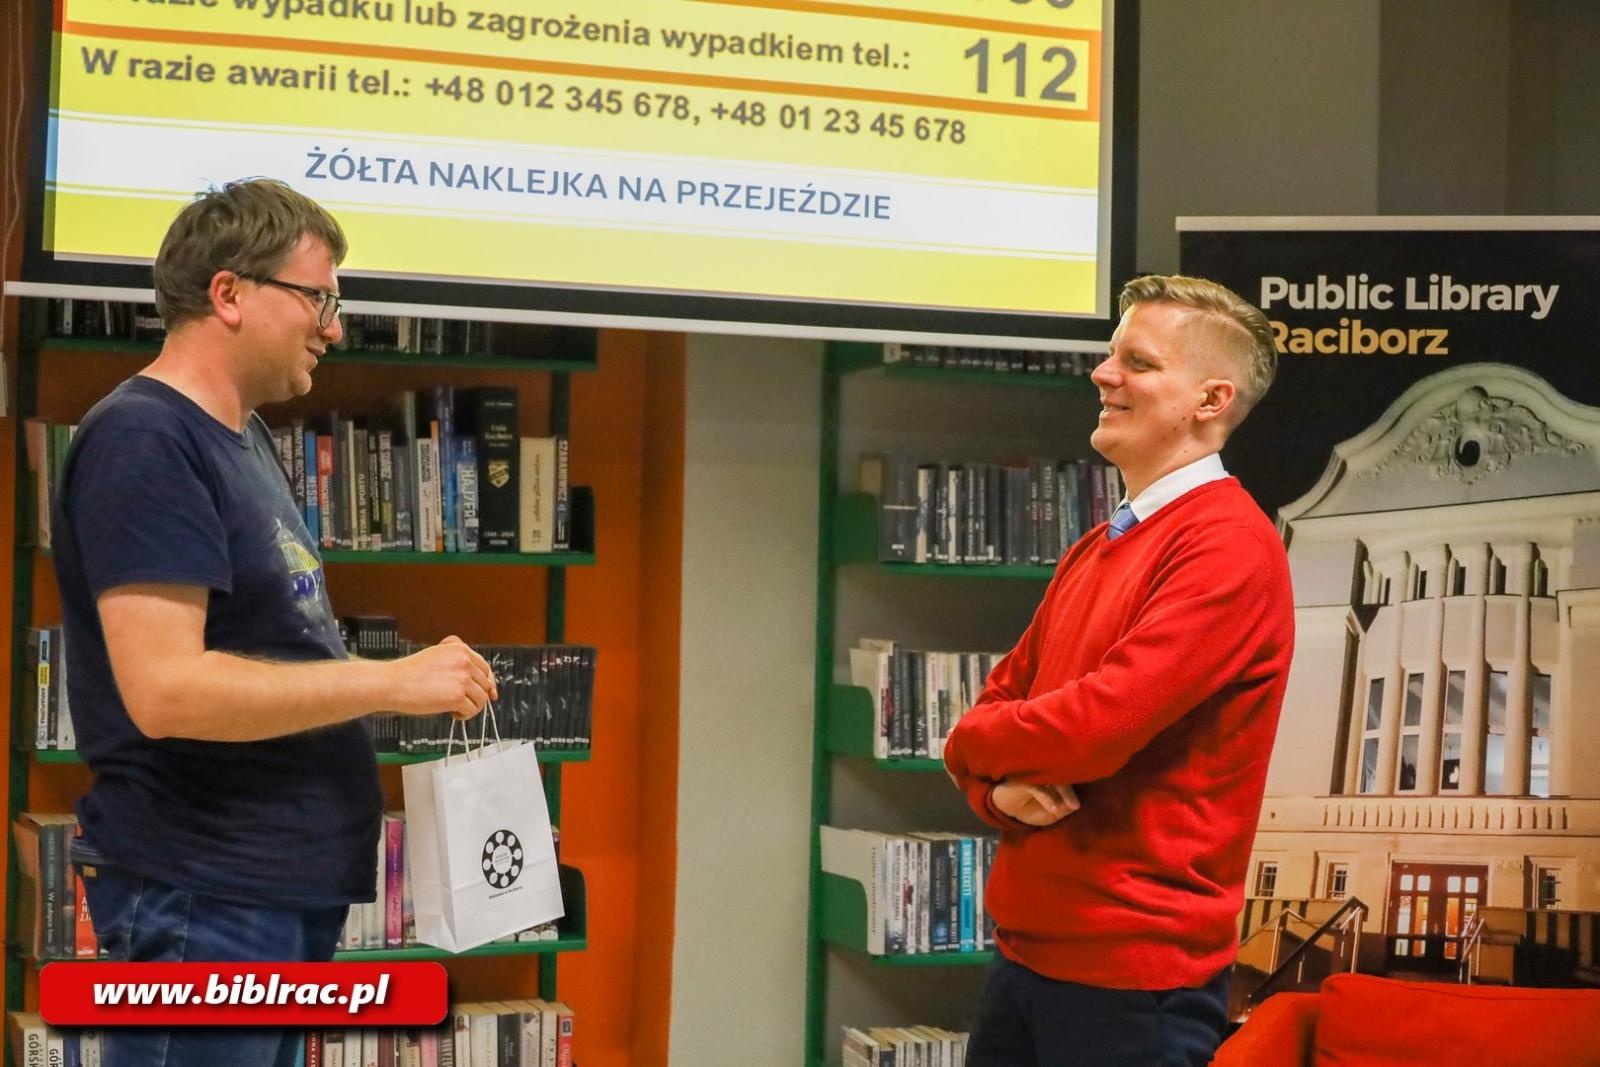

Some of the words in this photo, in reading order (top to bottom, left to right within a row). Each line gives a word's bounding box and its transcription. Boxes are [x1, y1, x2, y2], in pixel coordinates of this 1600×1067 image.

[405, 0, 457, 28] lub
[467, 11, 651, 46] zagrożenia
[660, 28, 844, 64] wypadkiem
[852, 41, 911, 70] tel.:
[963, 38, 1078, 103] 112
[81, 46, 118, 76] W
[128, 55, 216, 84] razie
[227, 63, 337, 92] awarii
[347, 68, 411, 98] tel.:
[424, 76, 485, 104] +48
[496, 80, 555, 110] 012
[566, 86, 623, 116] 345
[634, 92, 701, 126] 678,
[710, 100, 767, 127] +48
[779, 104, 811, 131] 01
[824, 108, 861, 135] 23
[870, 112, 905, 139] 45
[914, 116, 966, 145] 678
[305, 146, 418, 186] ŻÓŁTA
[429, 161, 608, 199] NAKLEJKA
[618, 176, 667, 204] NA
[677, 180, 891, 220] PRZEJEŹDZIE
[1260, 274, 1394, 311] Public
[1405, 274, 1560, 320] Library
[1270, 317, 1449, 355] Raciborz
[295, 426, 304, 458] WAYNE
[306, 476, 317, 506] MESSI
[358, 474, 366, 506] SPORTU
[358, 509, 367, 548] HSTORIA
[962, 867, 971, 896] BECKETT
